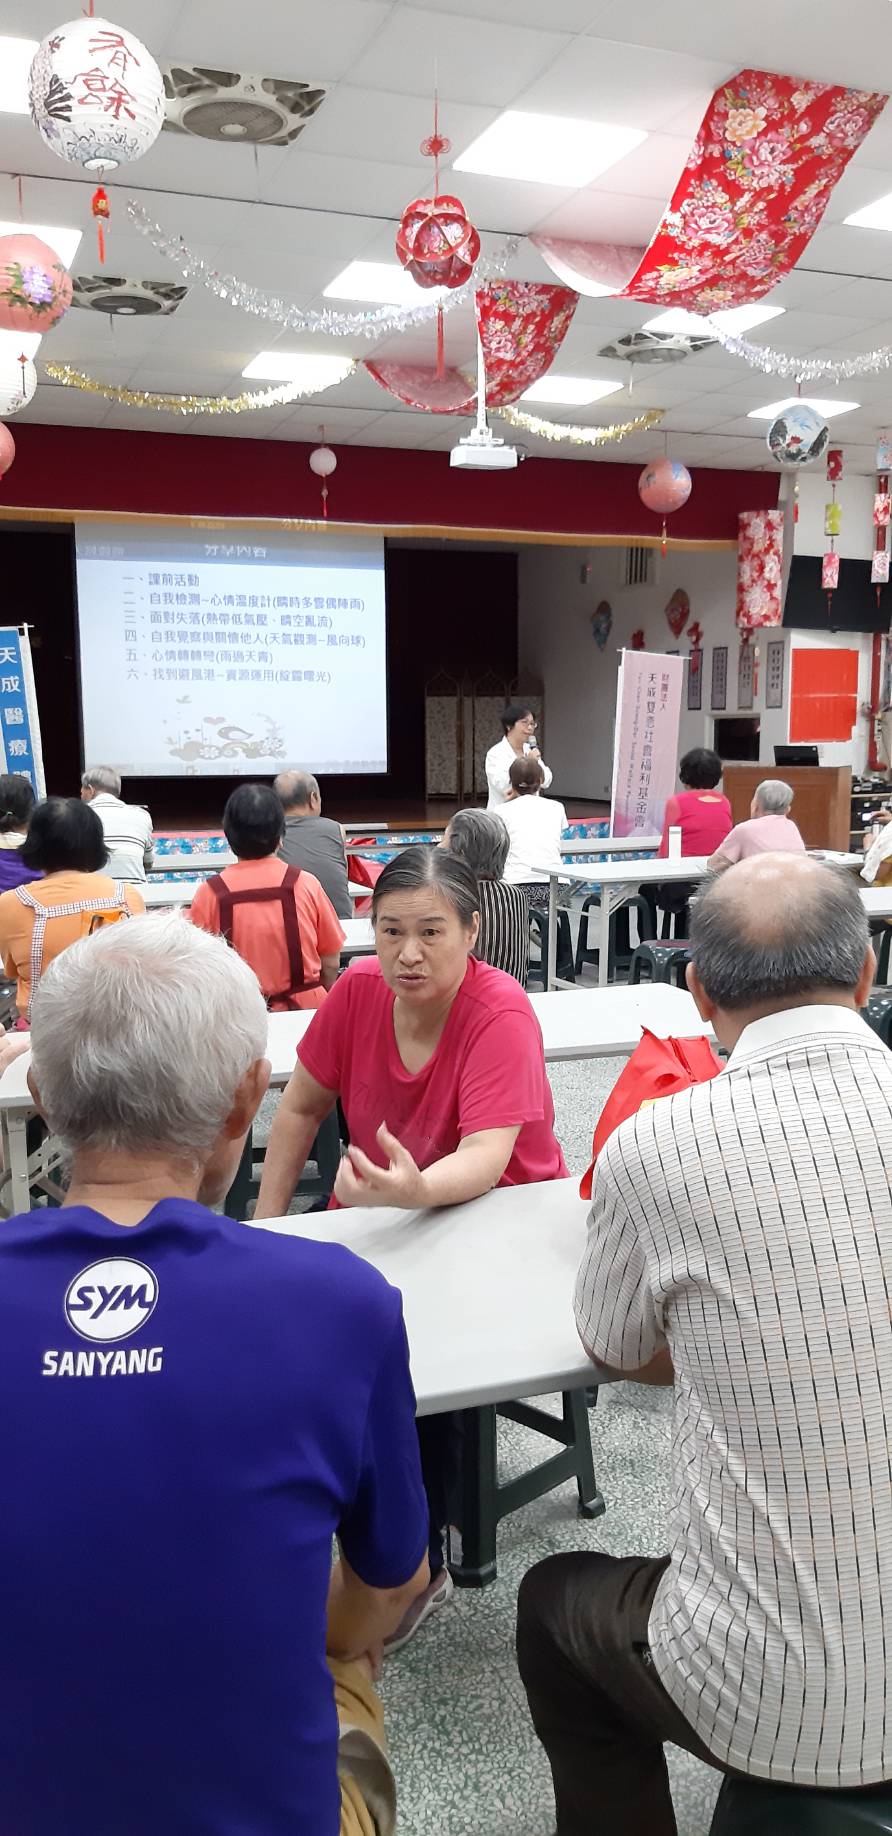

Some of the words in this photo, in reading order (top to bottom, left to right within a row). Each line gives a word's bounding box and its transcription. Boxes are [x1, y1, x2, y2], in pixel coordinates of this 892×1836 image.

[122, 573, 200, 587] 一、課前活動
[68, 1284, 154, 1320] SYM
[42, 1347, 163, 1377] SANYANG
